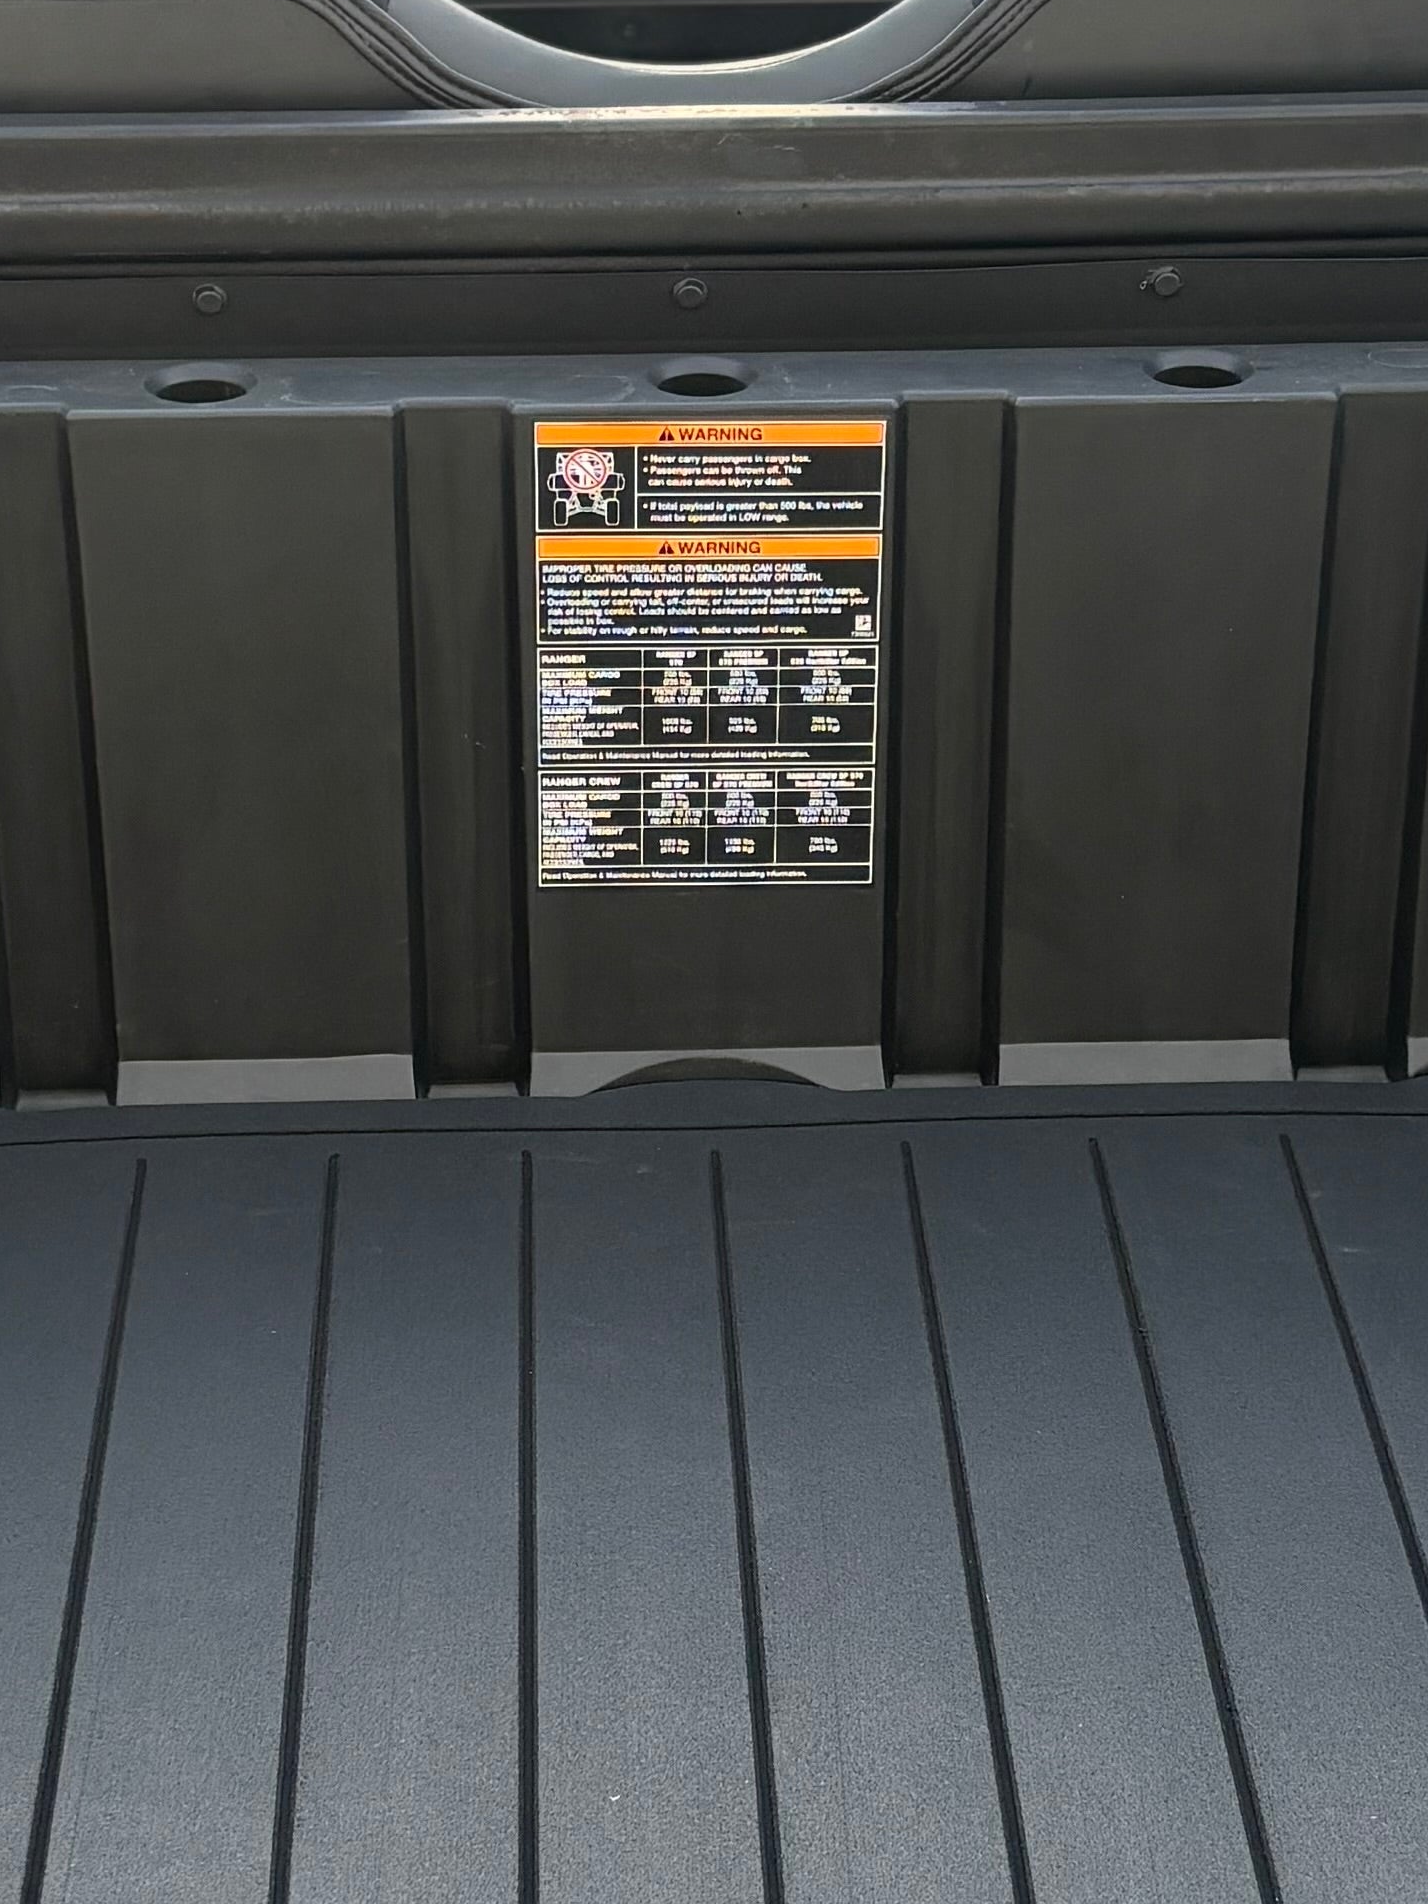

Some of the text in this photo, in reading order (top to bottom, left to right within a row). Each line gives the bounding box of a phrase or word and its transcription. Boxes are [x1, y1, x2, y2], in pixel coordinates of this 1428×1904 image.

[679, 428, 762, 441] WARNING
[650, 455, 675, 463] Never
[678, 456, 700, 465] carry
[703, 456, 752, 465] passengers
[755, 455, 763, 463] in
[765, 456, 790, 465] cargo
[650, 466, 700, 476] Passengers
[722, 466, 733, 474] be
[735, 466, 765, 474] thrown
[784, 466, 801, 474] This
[695, 478, 726, 486] serious
[728, 478, 751, 488] injury
[658, 502, 677, 510] total
[680, 502, 714, 512] payload
[716, 502, 724, 510] is
[726, 502, 756, 512] greater
[759, 501, 778, 510] than
[832, 501, 862, 509] vehicle
[688, 513, 726, 523] operated
[729, 513, 737, 521] in
[739, 513, 760, 521] LOW
[678, 542, 761, 554] WARNING
[542, 564, 806, 573] IMPROPER TIRE PRESSURE OR OVERLOADING CAN CAUSE
[542, 575, 567, 583] LOSS
[570, 574, 582, 583] OF
[584, 574, 628, 583] CONTROL
[631, 574, 682, 582] RESULTING
[685, 574, 694, 582] IN
[697, 574, 737, 582] SERIOUS
[739, 574, 772, 582] INJURY
[611, 588, 627, 596] and
[654, 589, 684, 597] greater
[739, 588, 771, 597] braking
[799, 588, 833, 597] carrying
[547, 598, 599, 607] Overloading
[612, 598, 646, 607] carrying
[796, 597, 810, 605] will
[851, 598, 869, 606] your
[667, 607, 696, 615] should
[698, 607, 709, 615] be
[711, 607, 749, 615] centered
[751, 607, 767, 615] and
[547, 627, 561, 635] For
[542, 655, 586, 664] RANGER
[542, 778, 620, 787] RANGER CREW
